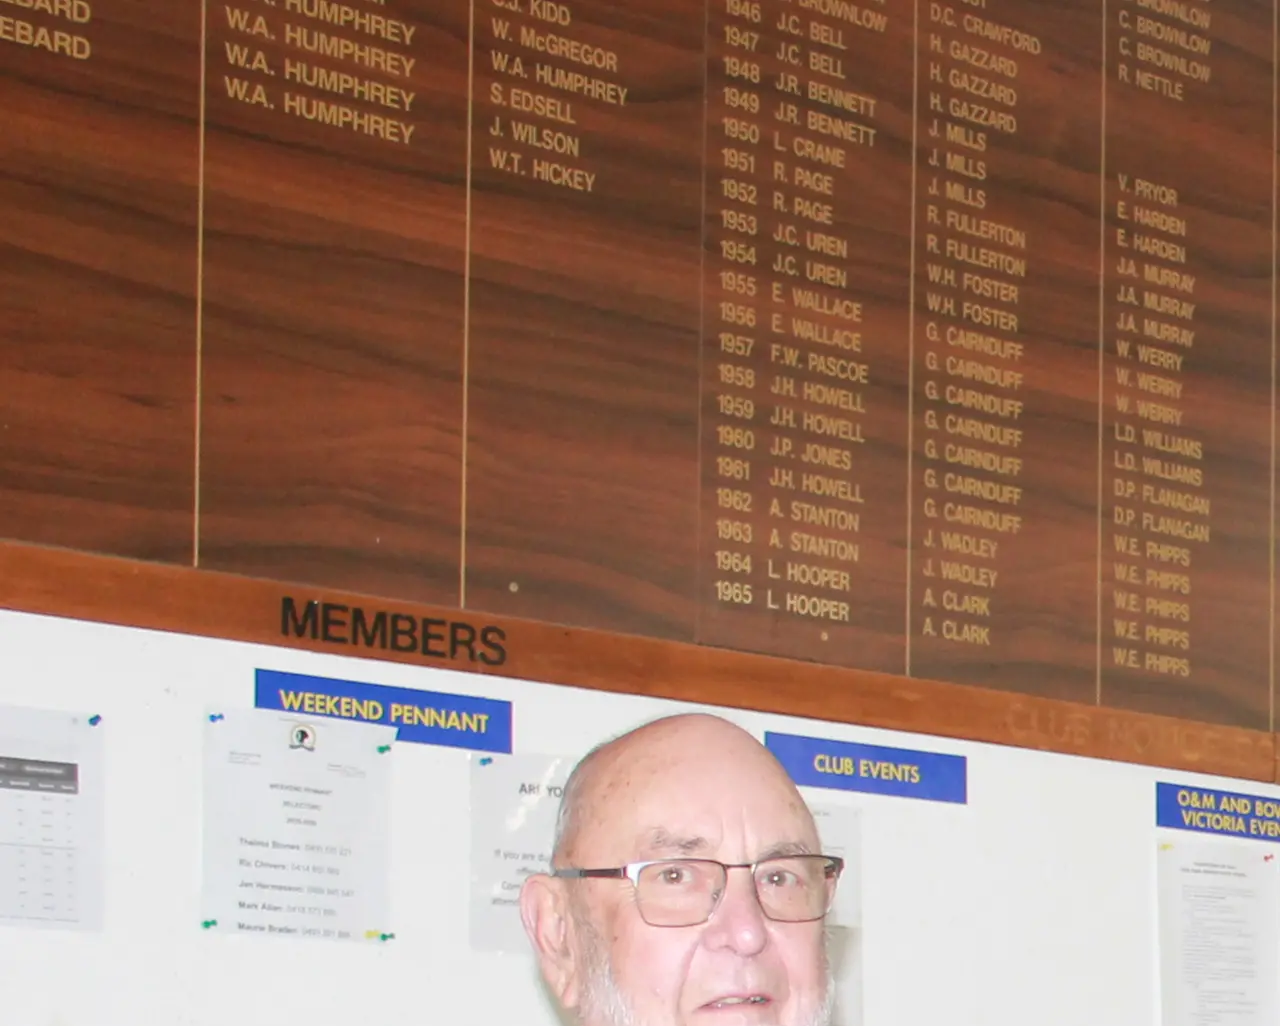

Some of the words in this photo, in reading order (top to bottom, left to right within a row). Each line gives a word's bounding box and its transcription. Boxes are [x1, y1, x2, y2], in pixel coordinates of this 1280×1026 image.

[529, 0, 571, 26] KIDD
[224, 5, 276, 41] W.A.
[284, 23, 416, 78] HUMPHREY
[491, 17, 513, 42] W.
[520, 25, 618, 73] McGREGOR
[224, 41, 276, 76] W.A.
[284, 58, 416, 112] HUMPHREY
[491, 49, 528, 79] W.A.
[535, 63, 628, 106] HUMPHREY
[1135, 69, 1183, 102] NETTLE
[223, 75, 275, 110] W.A.
[283, 91, 416, 145] HUMPHREY
[490, 82, 506, 107] S.
[510, 90, 577, 125] EDSELL
[489, 116, 504, 137] J.
[511, 120, 579, 158] WILSON
[722, 117, 760, 144] 1950
[946, 122, 986, 152] MILLS
[489, 147, 526, 176] W.T.
[532, 158, 596, 193] HICKEY
[1134, 178, 1178, 207] PRYOR
[1116, 200, 1129, 220] E.
[1133, 205, 1186, 237] HARDEN
[719, 239, 757, 266] 1954
[772, 253, 802, 276] J.C.
[806, 261, 847, 289] UREN
[946, 238, 1026, 277] FULLERTON
[719, 271, 757, 297] 1955
[772, 281, 787, 303] E.
[792, 288, 862, 322] WALLACE
[927, 263, 959, 287] W.H.
[963, 272, 1019, 304] FOSTER
[1144, 264, 1196, 294] MURRAY
[719, 302, 756, 328] 1956
[771, 313, 785, 334] E.
[792, 317, 862, 353] WALLACE
[946, 326, 1024, 360] CAIRNDUFF
[718, 332, 755, 357] 1957
[770, 343, 803, 368] F.W.
[808, 352, 869, 384] PASCOE
[717, 394, 755, 420] 1959
[770, 405, 797, 428] J.H.
[803, 412, 865, 443] HOWELL
[716, 425, 755, 451] 1960
[770, 436, 795, 457] J.P.
[801, 443, 852, 471] JONES
[716, 456, 750, 481] 1961
[769, 467, 796, 490] J.H.
[802, 473, 865, 504] HOWELL
[1142, 457, 1203, 487] WILLIAMS
[716, 487, 752, 513] 1962
[769, 497, 785, 518] A.
[790, 501, 860, 532] STANTON
[944, 502, 1022, 533] CAIRNDUFF
[1142, 484, 1210, 516] FLANAGAN
[714, 550, 752, 574] 1964
[767, 558, 781, 579] L.
[786, 562, 851, 592] HOOPER
[940, 561, 998, 588] WADLEY
[714, 579, 753, 605] 1965
[766, 588, 780, 610] L.
[785, 592, 850, 622] HOOPER
[942, 590, 990, 617] CLARK
[280, 595, 507, 667] MEMBERS
[1144, 653, 1191, 678] PHIPPS
[278, 688, 384, 722] WEEKEND
[389, 703, 489, 734] PENNANT
[813, 754, 855, 776] CLUB
[859, 760, 921, 784] EVENTS
[547, 787, 564, 797] YO
[1176, 788, 1216, 810] O&M
[1219, 796, 1252, 815] AND
[1181, 809, 1247, 834] VICTORIA
